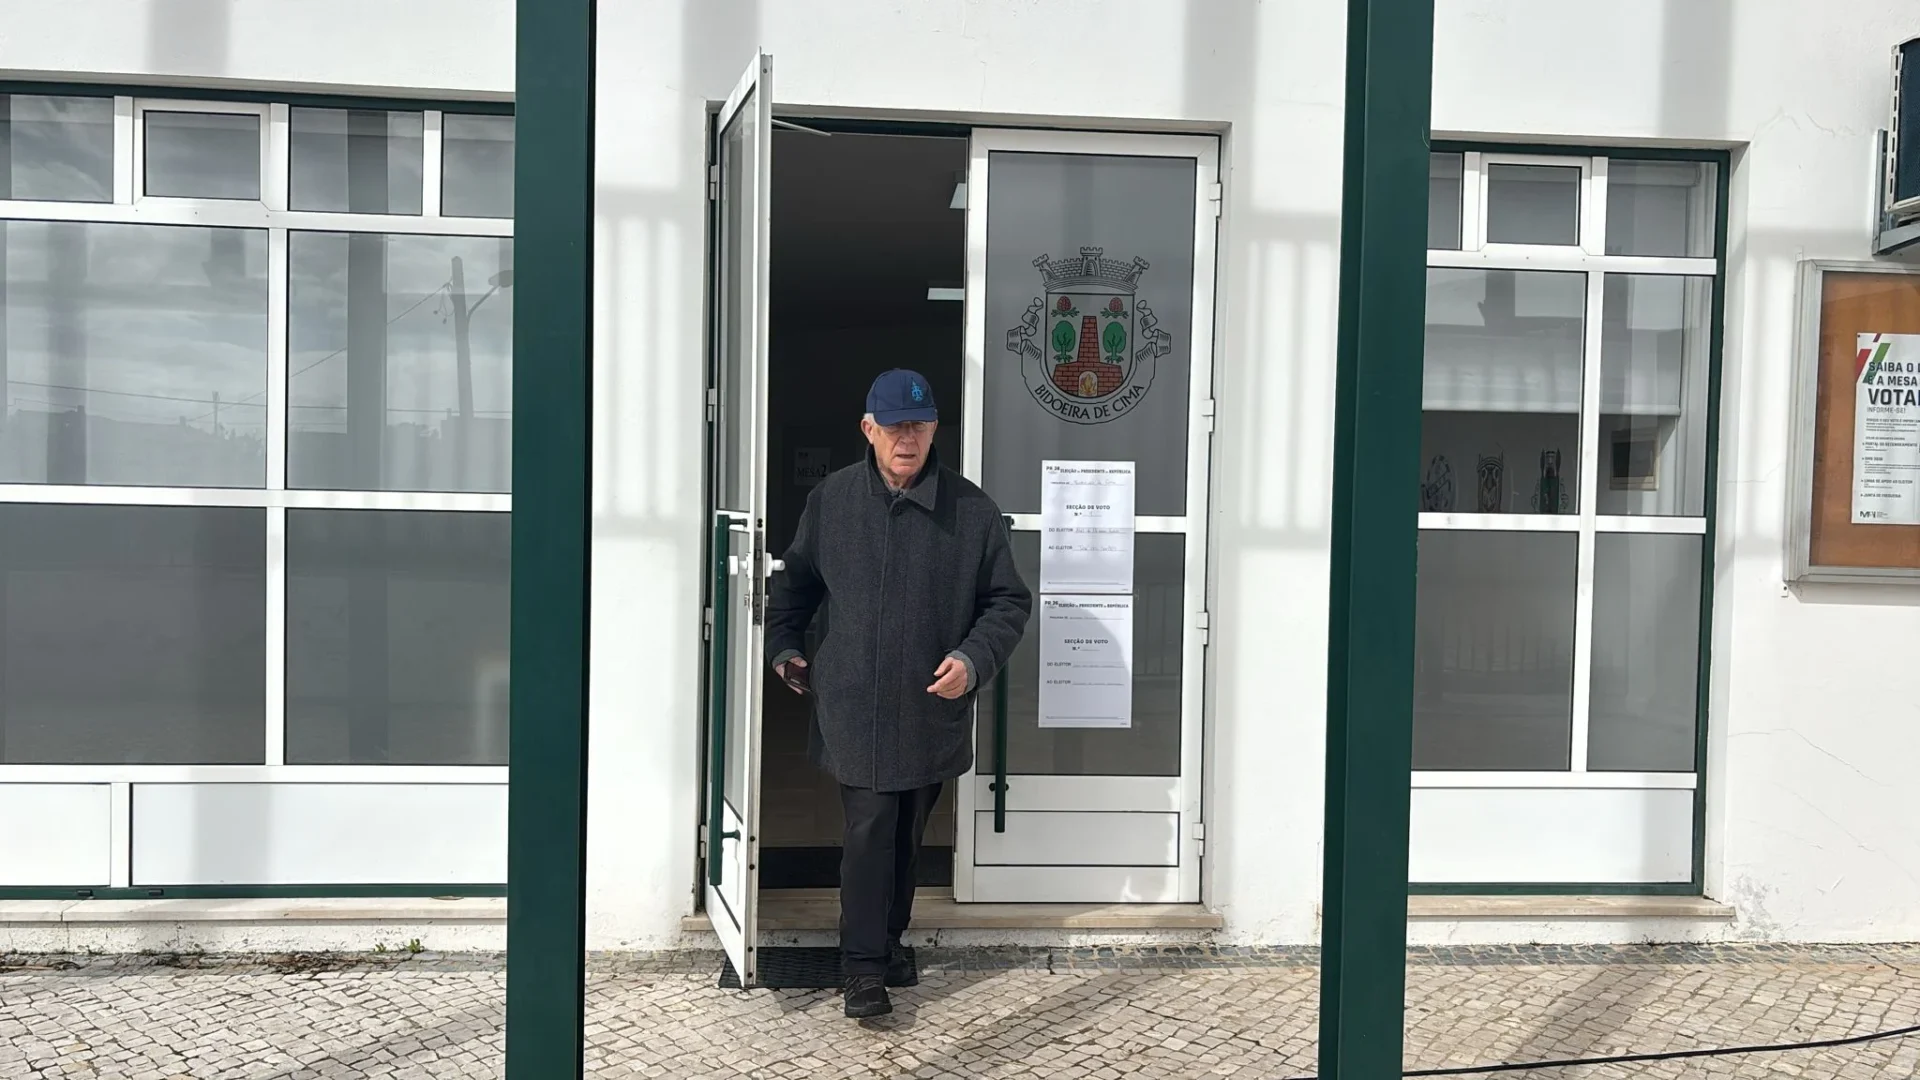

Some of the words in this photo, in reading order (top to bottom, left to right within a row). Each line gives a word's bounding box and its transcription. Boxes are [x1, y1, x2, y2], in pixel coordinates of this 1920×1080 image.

[1868, 362, 1902, 372] SAIBA
[1906, 362, 1914, 372] O
[1876, 376, 1884, 386] A
[1888, 376, 1918, 386] MESA
[1034, 384, 1090, 419] BIDOEIRA
[1094, 404, 1111, 419] DE
[1112, 384, 1145, 412] CIMA
[1868, 388, 1920, 406] VOTA
